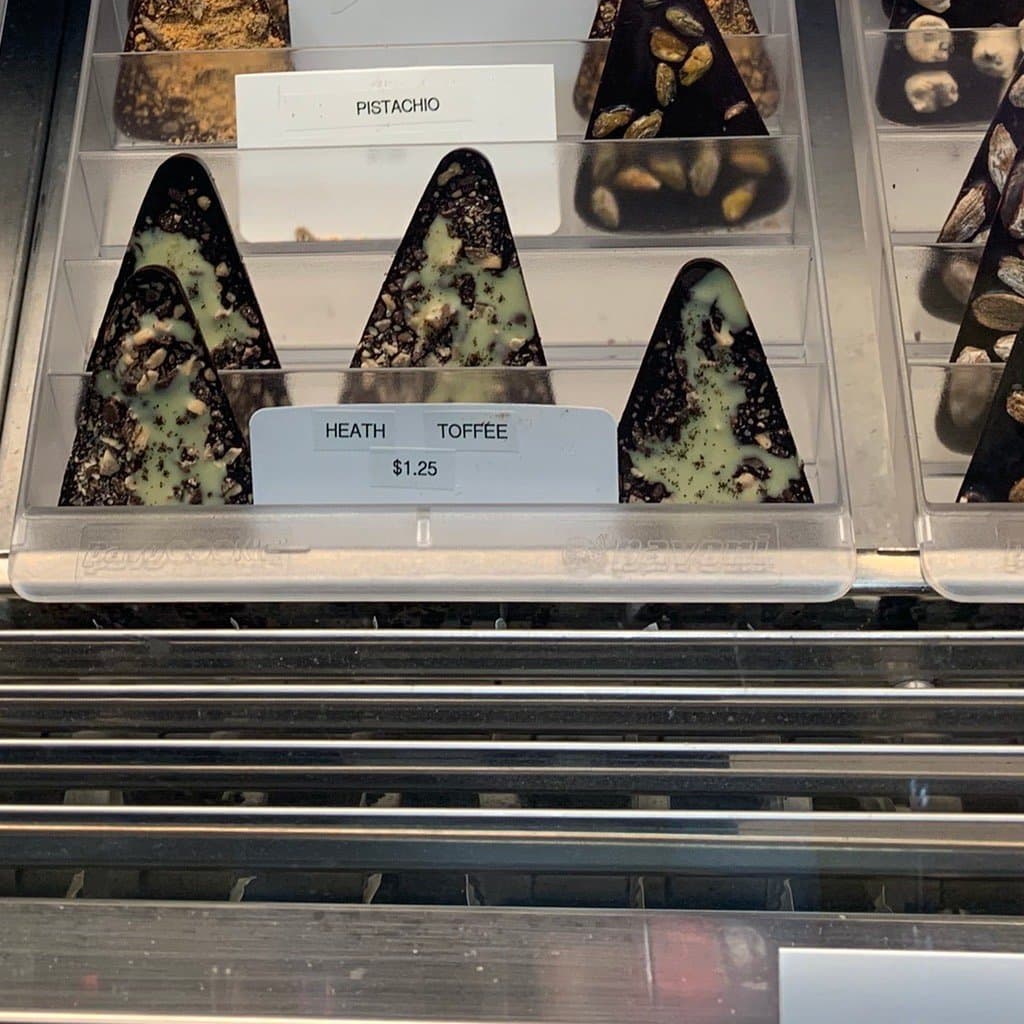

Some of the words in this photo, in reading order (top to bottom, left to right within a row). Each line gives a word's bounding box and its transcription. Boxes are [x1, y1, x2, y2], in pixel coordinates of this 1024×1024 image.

[356, 97, 440, 116] PISTACHIO
[326, 422, 386, 439] HEATH
[437, 422, 508, 440] TOFFEE
[392, 459, 438, 477] $1.25
